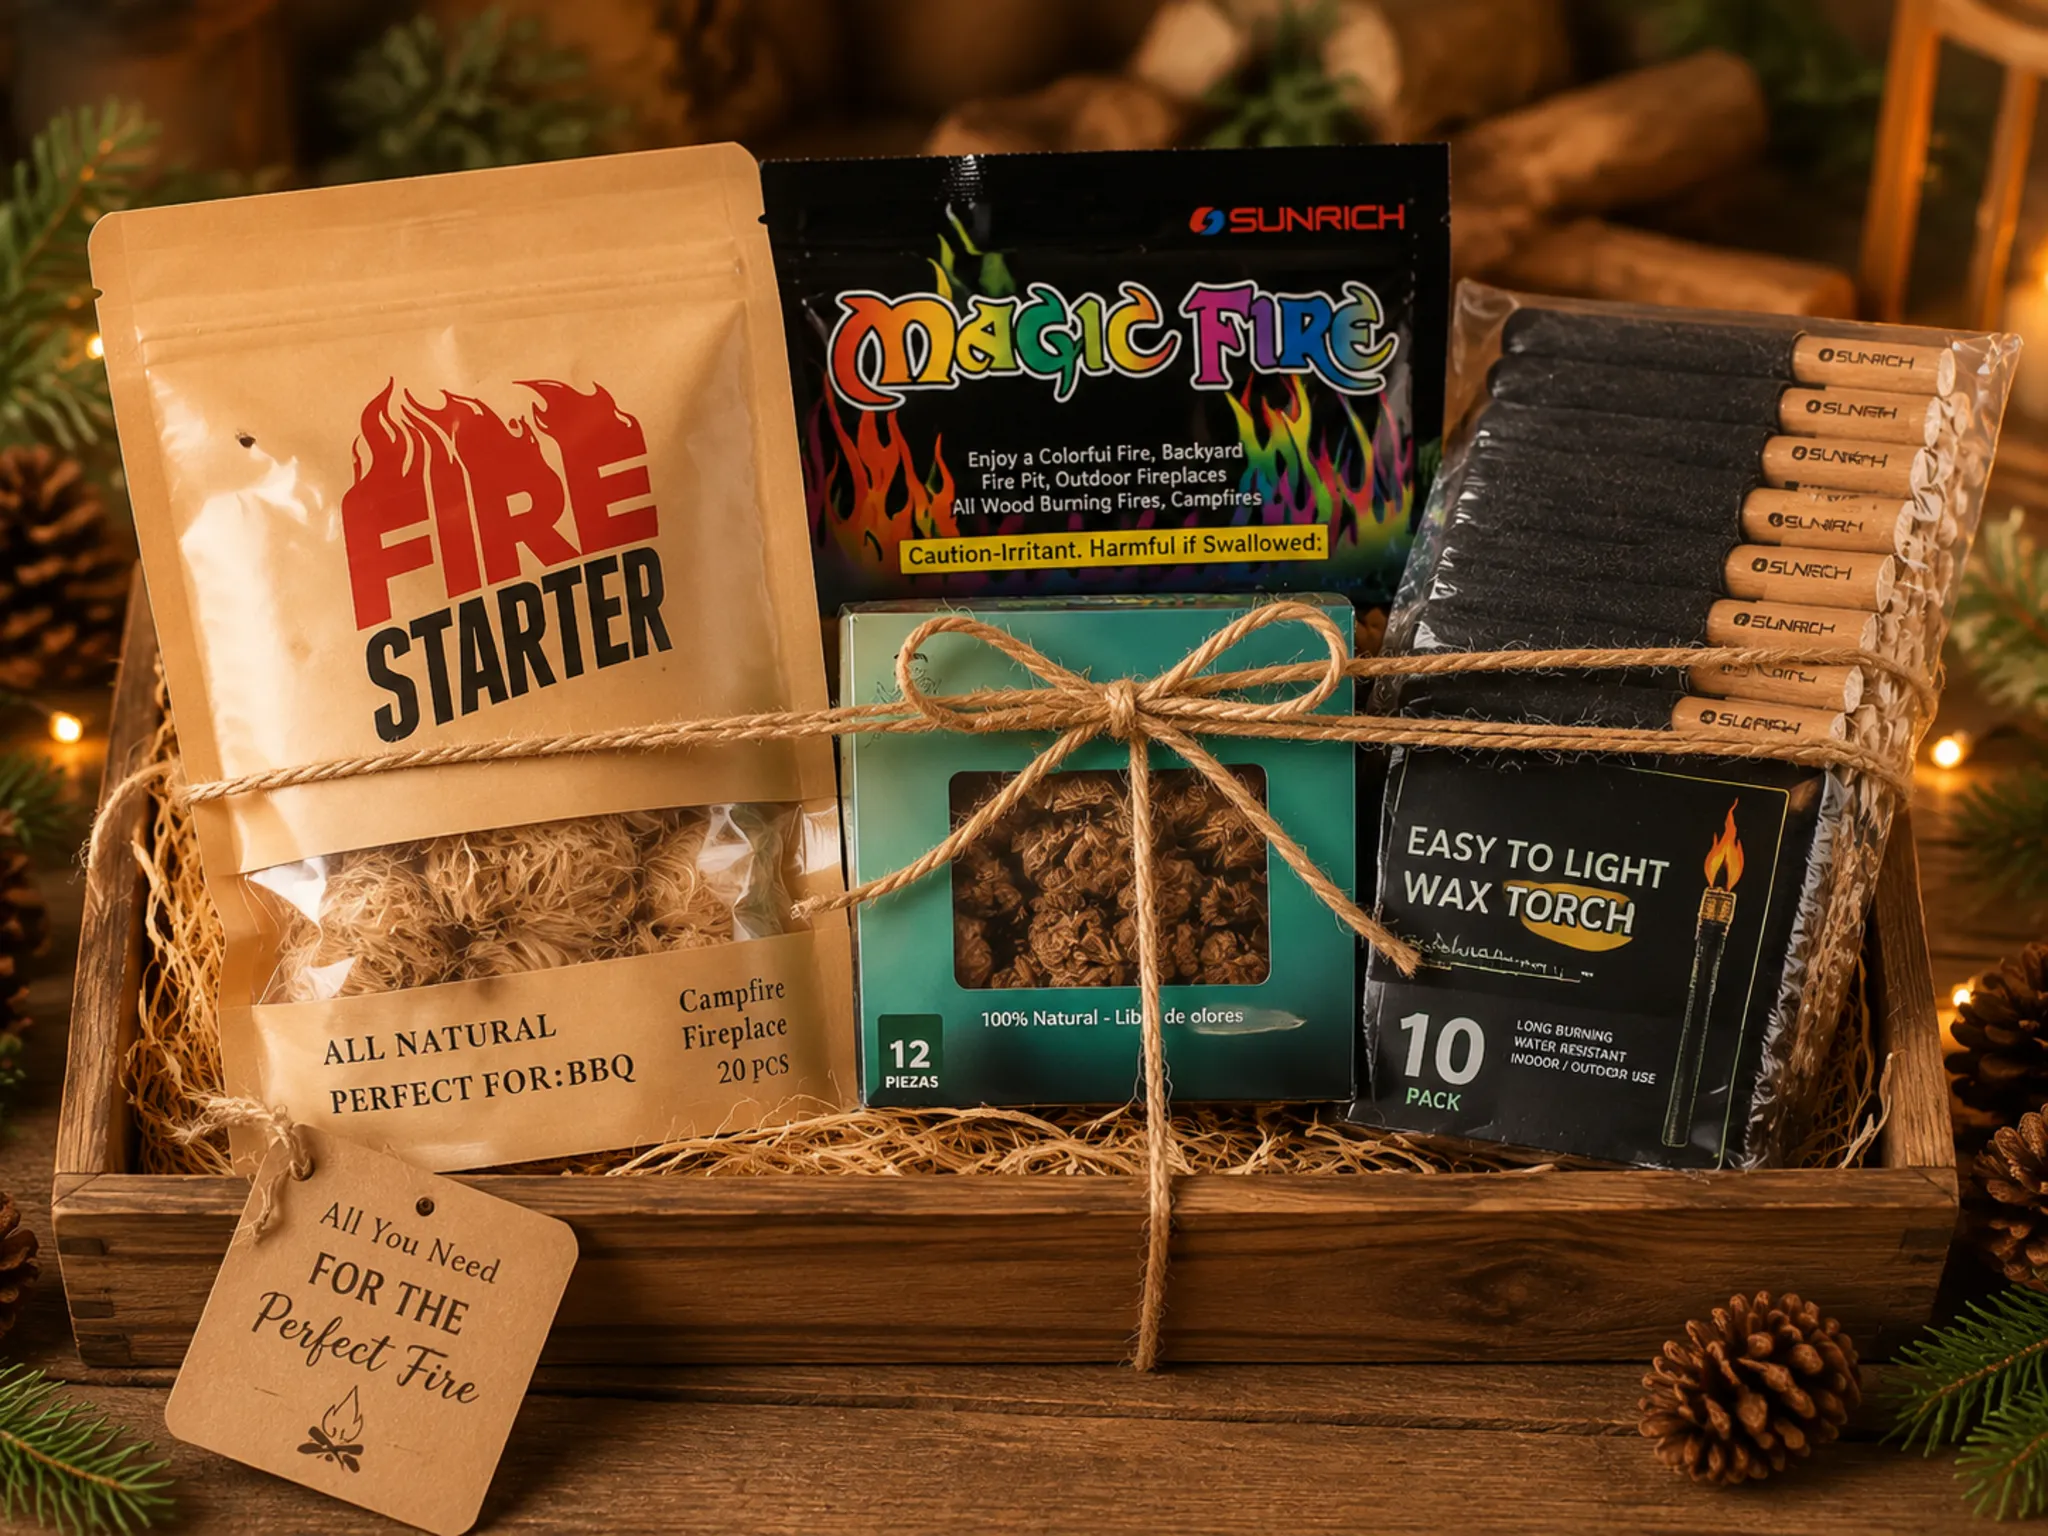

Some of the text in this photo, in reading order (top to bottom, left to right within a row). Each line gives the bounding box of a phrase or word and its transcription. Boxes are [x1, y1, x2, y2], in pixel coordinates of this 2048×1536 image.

[1229, 203, 1405, 233] SUNRICH
[826, 280, 1399, 410] MAGIC FIRE
[968, 449, 1018, 470] Enjoy
[1023, 452, 1034, 467] a
[1117, 443, 1155, 463] Fire,
[1162, 441, 1244, 461] Backyard
[981, 467, 1227, 491] Fire Pit, Outdoor Fireplaces
[341, 376, 659, 632] FIRE
[952, 489, 1263, 516] All Wood Burning Fires, Campfires
[908, 539, 1082, 566] Caution-Irritant.
[1090, 535, 1176, 558] Harmful
[1183, 534, 1197, 556] if
[365, 547, 673, 743] STARTER
[1407, 825, 1670, 889] EASY TO LIGHT
[1404, 870, 1637, 934] WAX TORCH
[679, 977, 786, 1013] Campfire
[681, 1016, 788, 1050] Fireplace
[981, 1010, 1028, 1028] 100%
[1033, 1009, 1098, 1026] Natural
[1115, 1009, 1148, 1025] Lib
[1164, 1007, 1185, 1024] de
[1190, 1007, 1244, 1024] olores
[1516, 1019, 1614, 1044] LONG BURNING
[323, 1013, 557, 1065] ALL NATURAL
[889, 1040, 931, 1069] 12
[1400, 1012, 1485, 1086] 10
[1514, 1035, 1557, 1053] WATER
[717, 1053, 790, 1084] 20 PCS
[885, 1075, 939, 1089] PIEZAS
[1562, 1060, 1569, 1072] /
[1631, 1070, 1657, 1085] USE
[330, 1075, 473, 1114] PERFECT
[1405, 1087, 1462, 1112] PACK
[320, 1202, 502, 1284] All You Need
[308, 1251, 470, 1336] FOR THE
[251, 1291, 480, 1404] Perfect Fire
